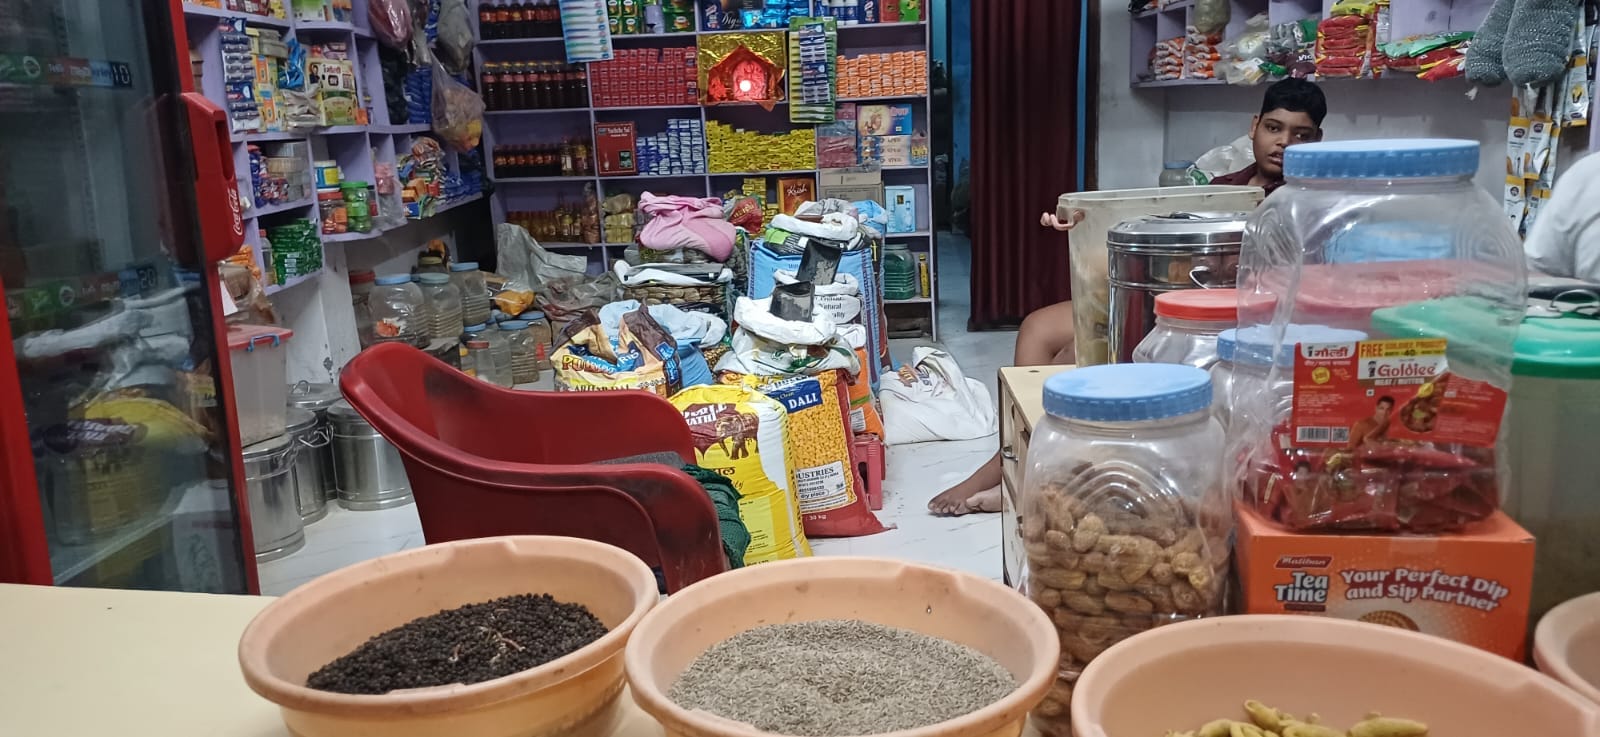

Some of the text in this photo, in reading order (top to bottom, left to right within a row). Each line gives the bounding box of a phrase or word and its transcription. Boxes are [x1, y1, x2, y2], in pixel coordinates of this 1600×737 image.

[113, 65, 130, 84] 10
[786, 183, 808, 196] Krish
[1360, 344, 1383, 357] FREE
[1377, 362, 1436, 377] Goldiee
[788, 392, 818, 409] DALL
[797, 466, 834, 480] USTRIES
[1292, 571, 1328, 588] Tea
[1341, 568, 1509, 600] Your Perfect Dip
[1274, 584, 1327, 602] Time
[1346, 584, 1501, 612] and Sip Partner
